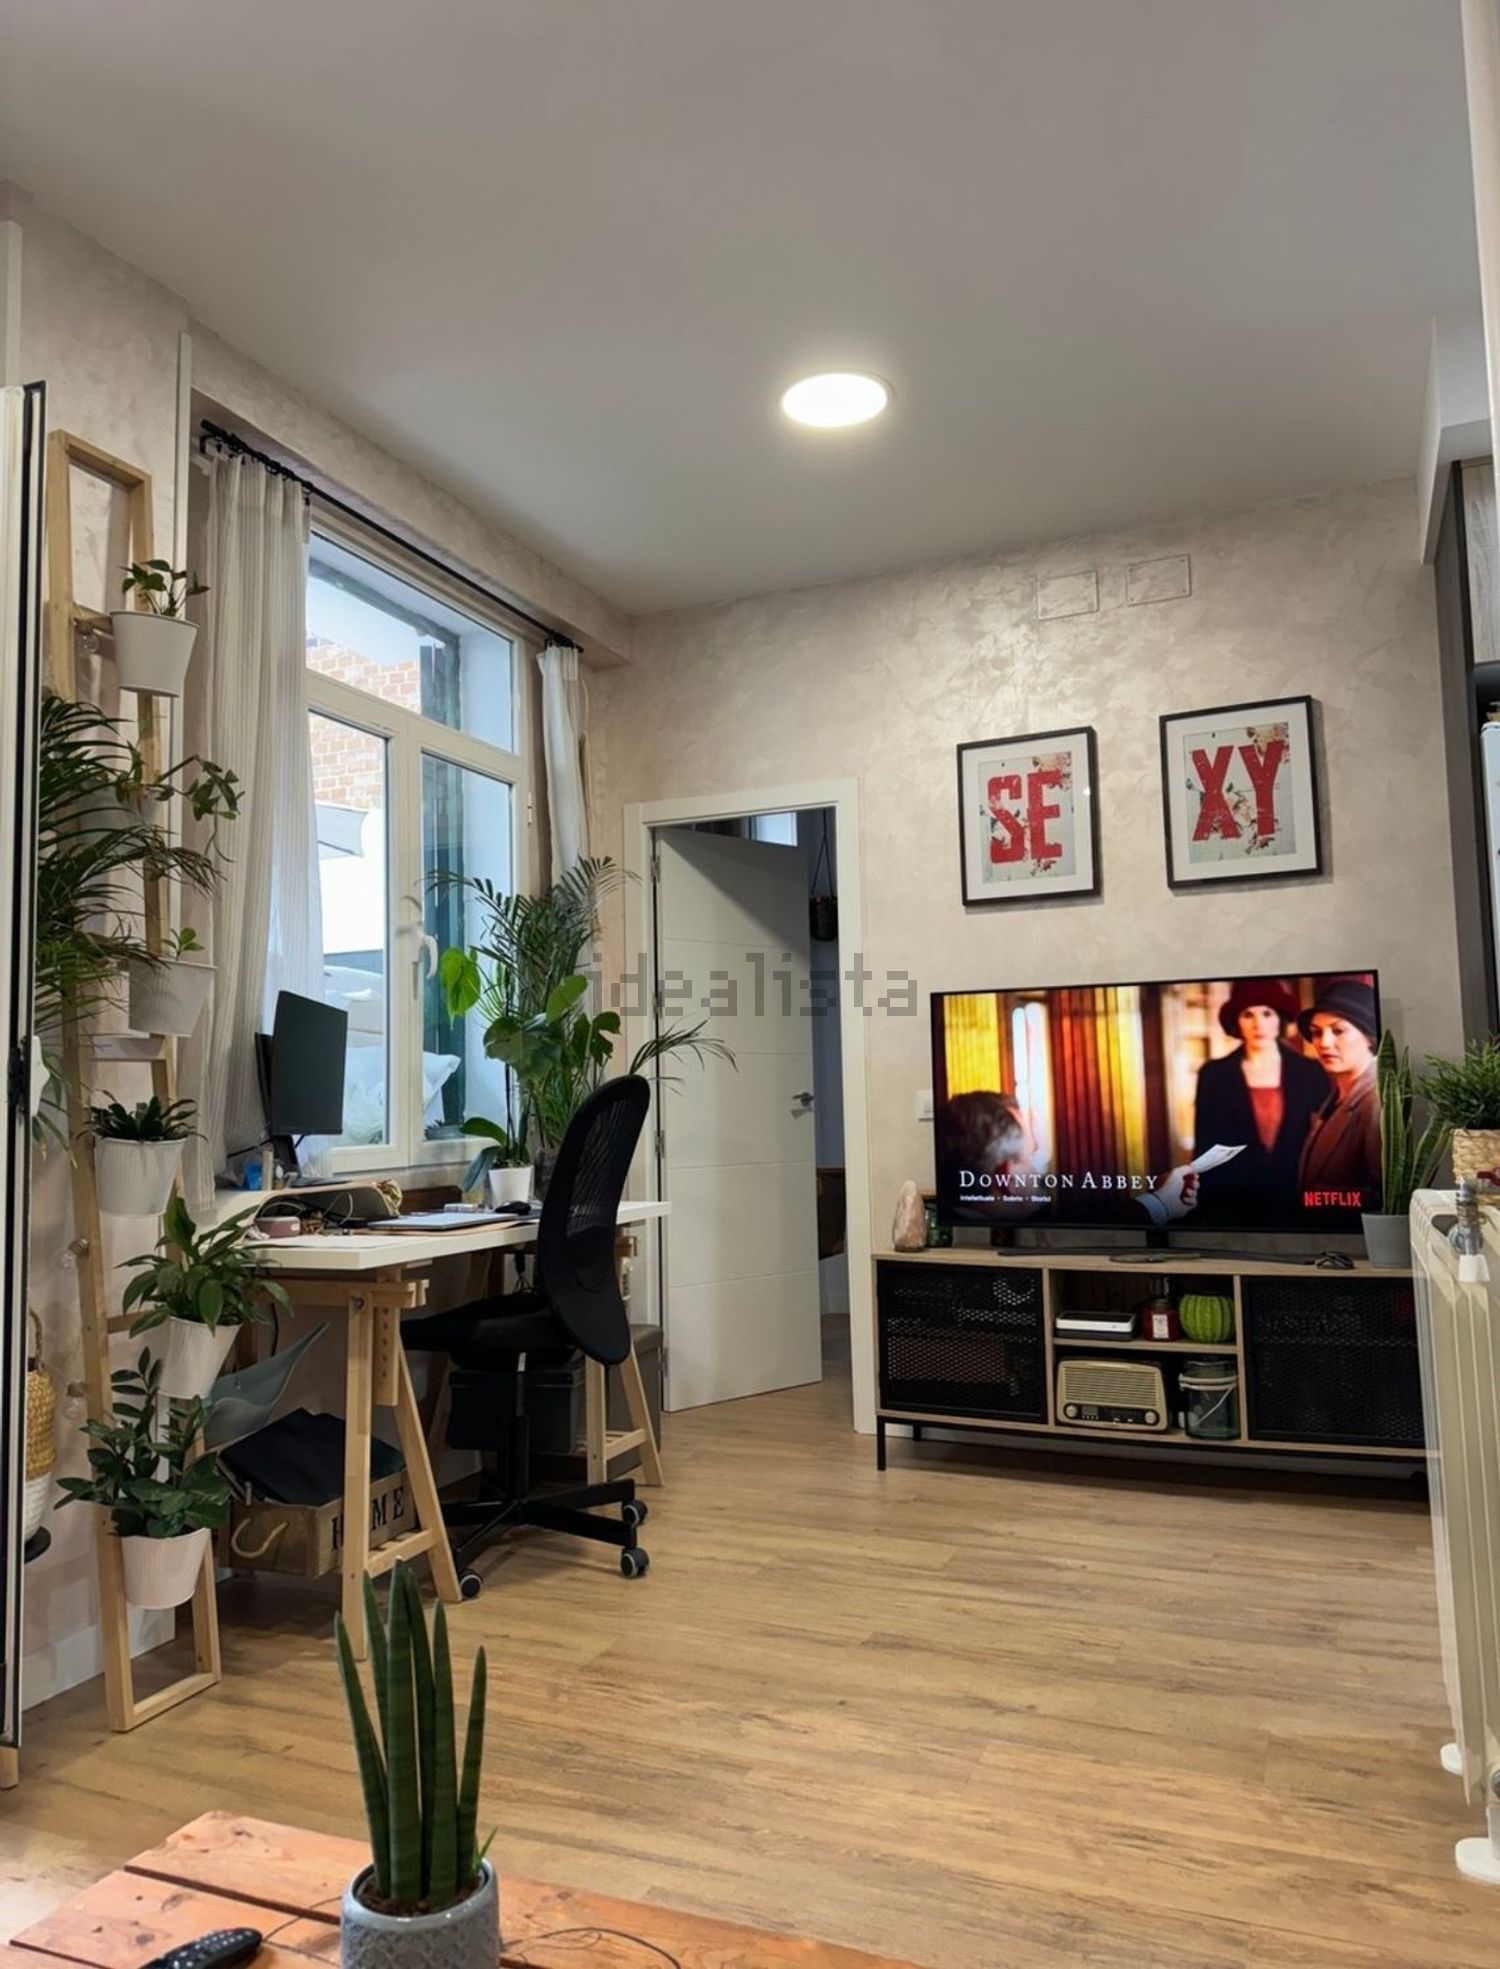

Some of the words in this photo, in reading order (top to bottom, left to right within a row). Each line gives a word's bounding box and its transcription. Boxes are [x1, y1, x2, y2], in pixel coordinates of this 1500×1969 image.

[987, 769, 1063, 864] SE
[1191, 740, 1286, 842] XY
[959, 1170, 1074, 1188] DOWNTON
[1081, 1171, 1158, 1190] ABBEY
[1304, 1191, 1361, 1207] NETFLIX
[331, 1486, 404, 1549] HME
